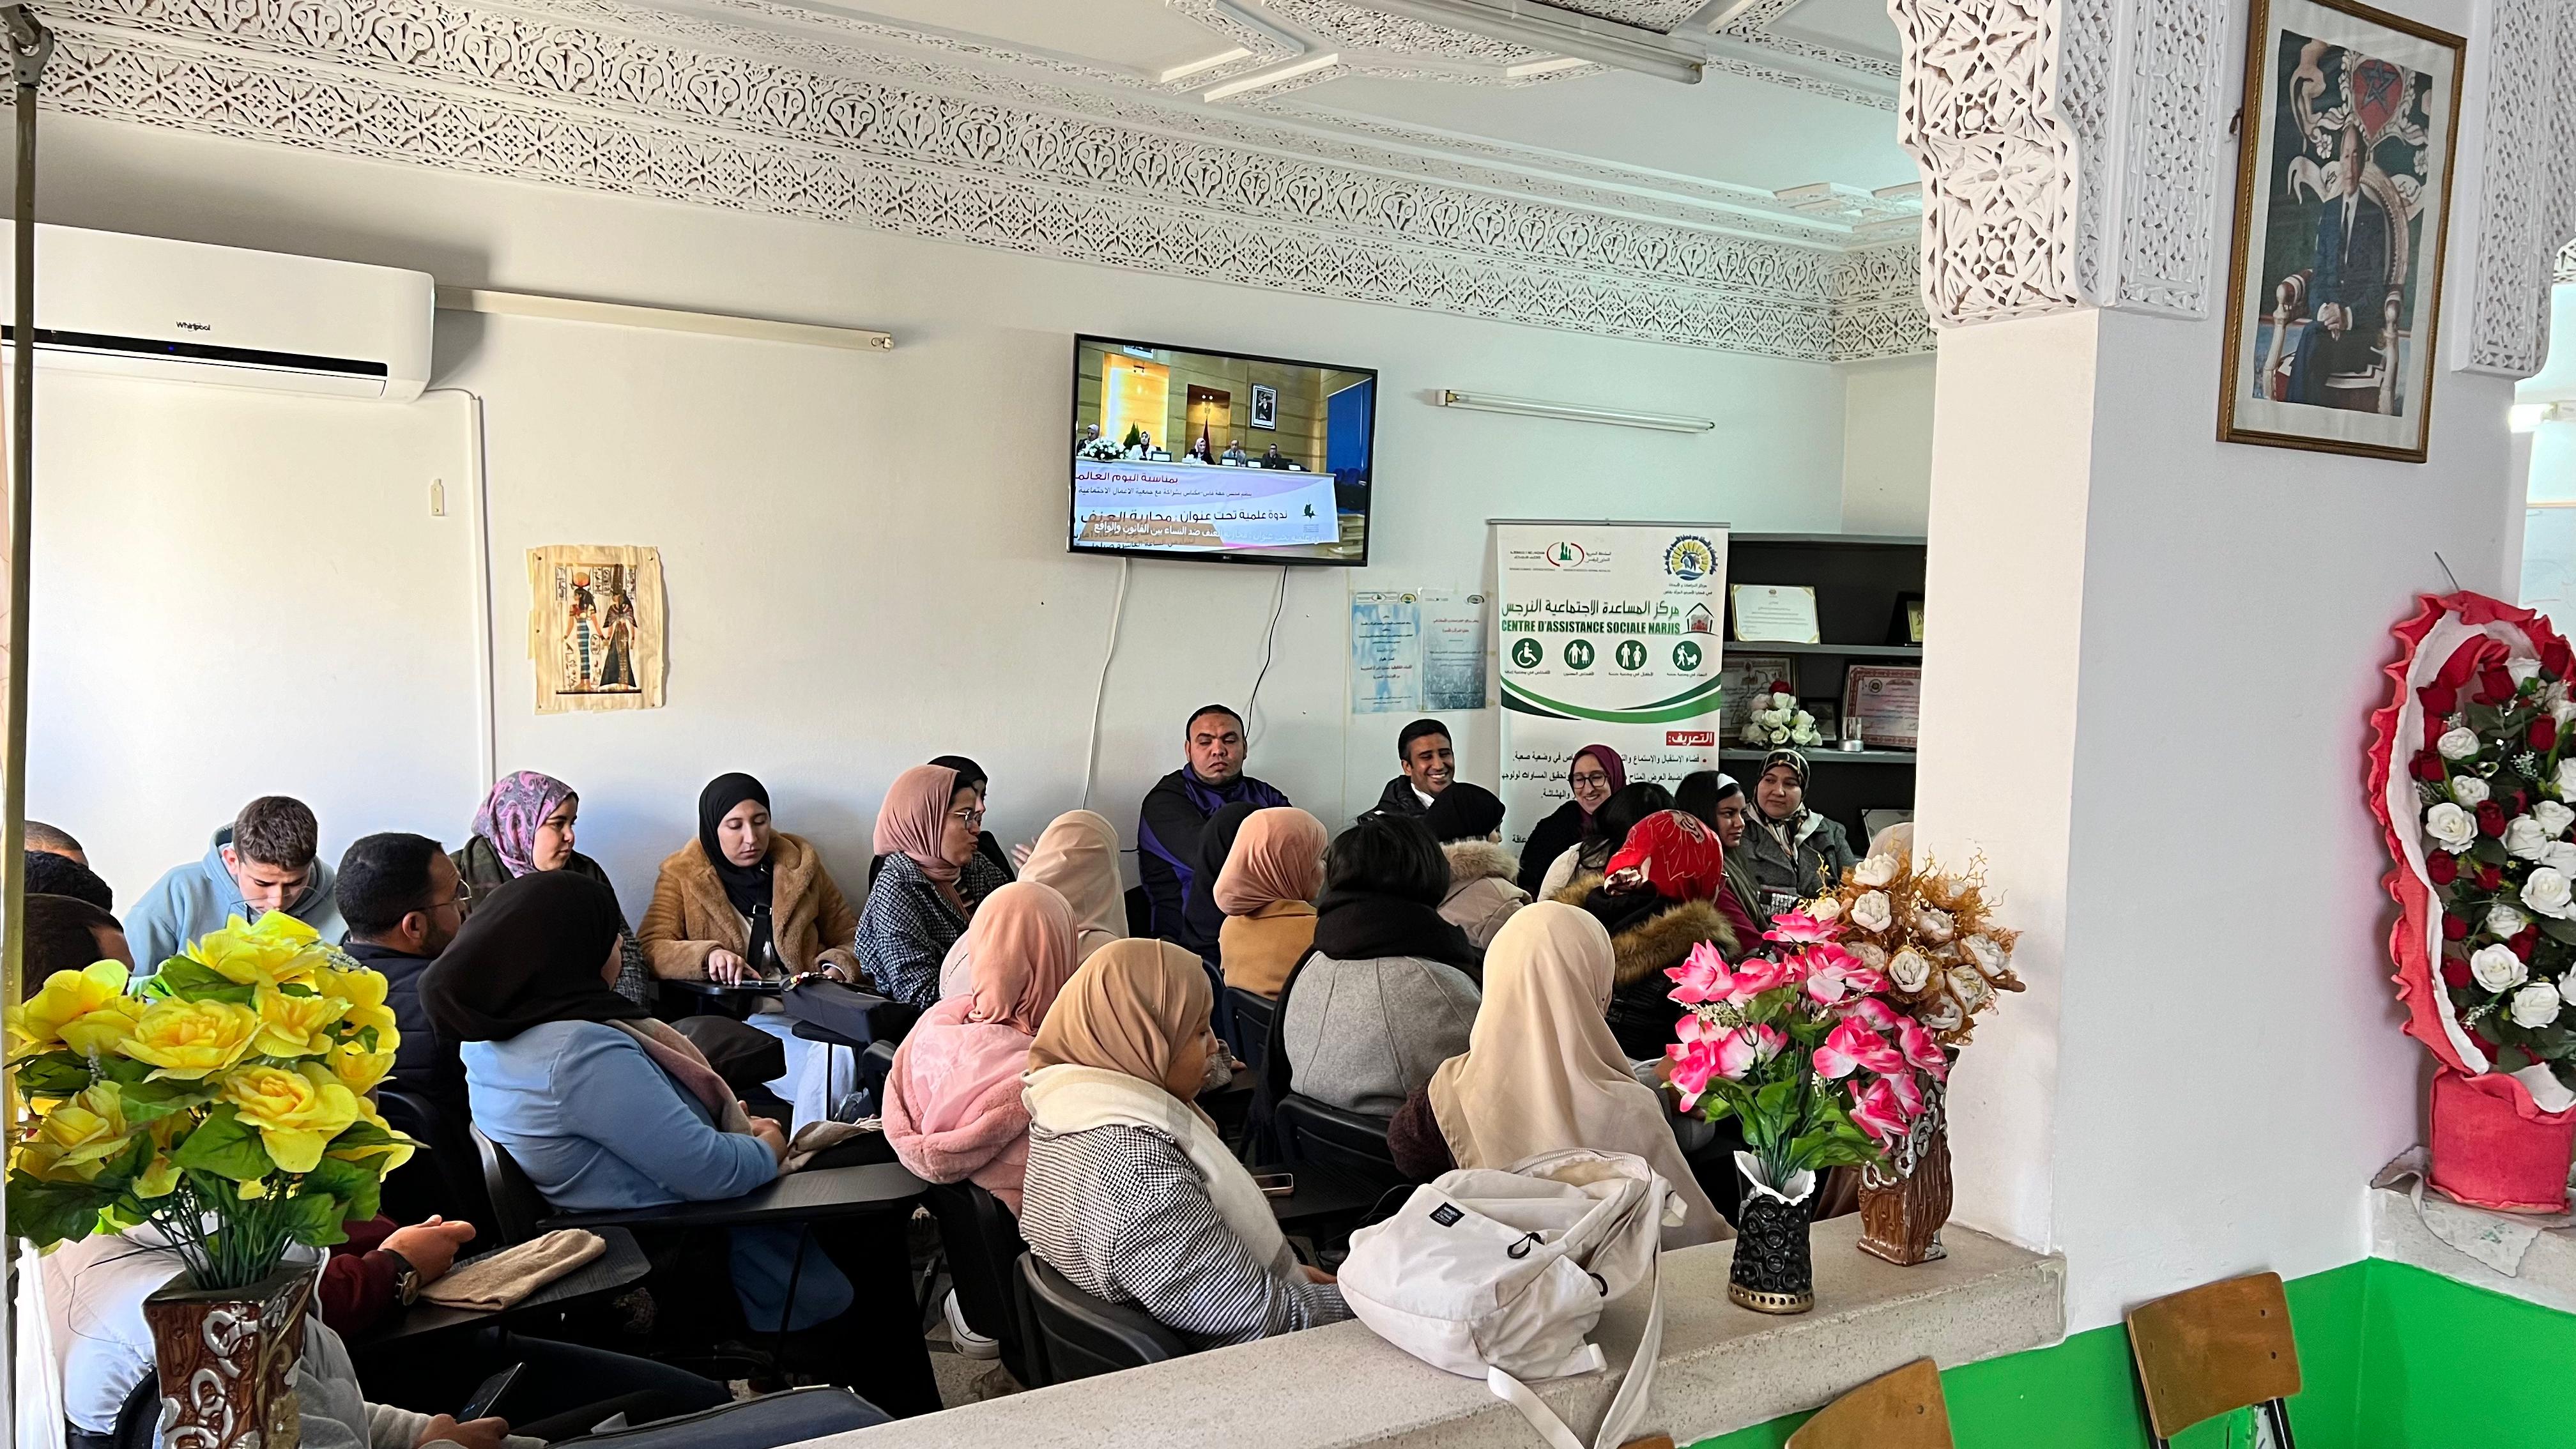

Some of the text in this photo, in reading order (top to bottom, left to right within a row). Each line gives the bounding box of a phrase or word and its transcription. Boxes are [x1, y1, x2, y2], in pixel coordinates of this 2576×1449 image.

[176, 321, 210, 331] Whirlpool
[1075, 471, 1178, 484] بمناسبة اليوم العالم
[1214, 509, 1237, 520] تحت
[1239, 509, 1267, 522] علمية
[1269, 510, 1287, 521] ندوة
[1094, 521, 1121, 533] والواقع
[1123, 522, 1149, 534] القانون
[1150, 525, 1163, 536] بين
[1164, 525, 1186, 535] النساء
[1501, 599, 1679, 619] مركز المساعدة الاجتماعية النرجس
[1501, 620, 1680, 634] CENTRE D'ASSISTANCE SOCIALE NARJIS
[1668, 732, 1712, 746] التعريف:
[1532, 751, 1551, 763] وضعية
[1552, 751, 1561, 763] في
[1685, 753, 1699, 763] فضاء
[1629, 772, 1646, 783] المتاح
[1648, 772, 1666, 783] العرض
[1512, 834, 1527, 843] عاقة
